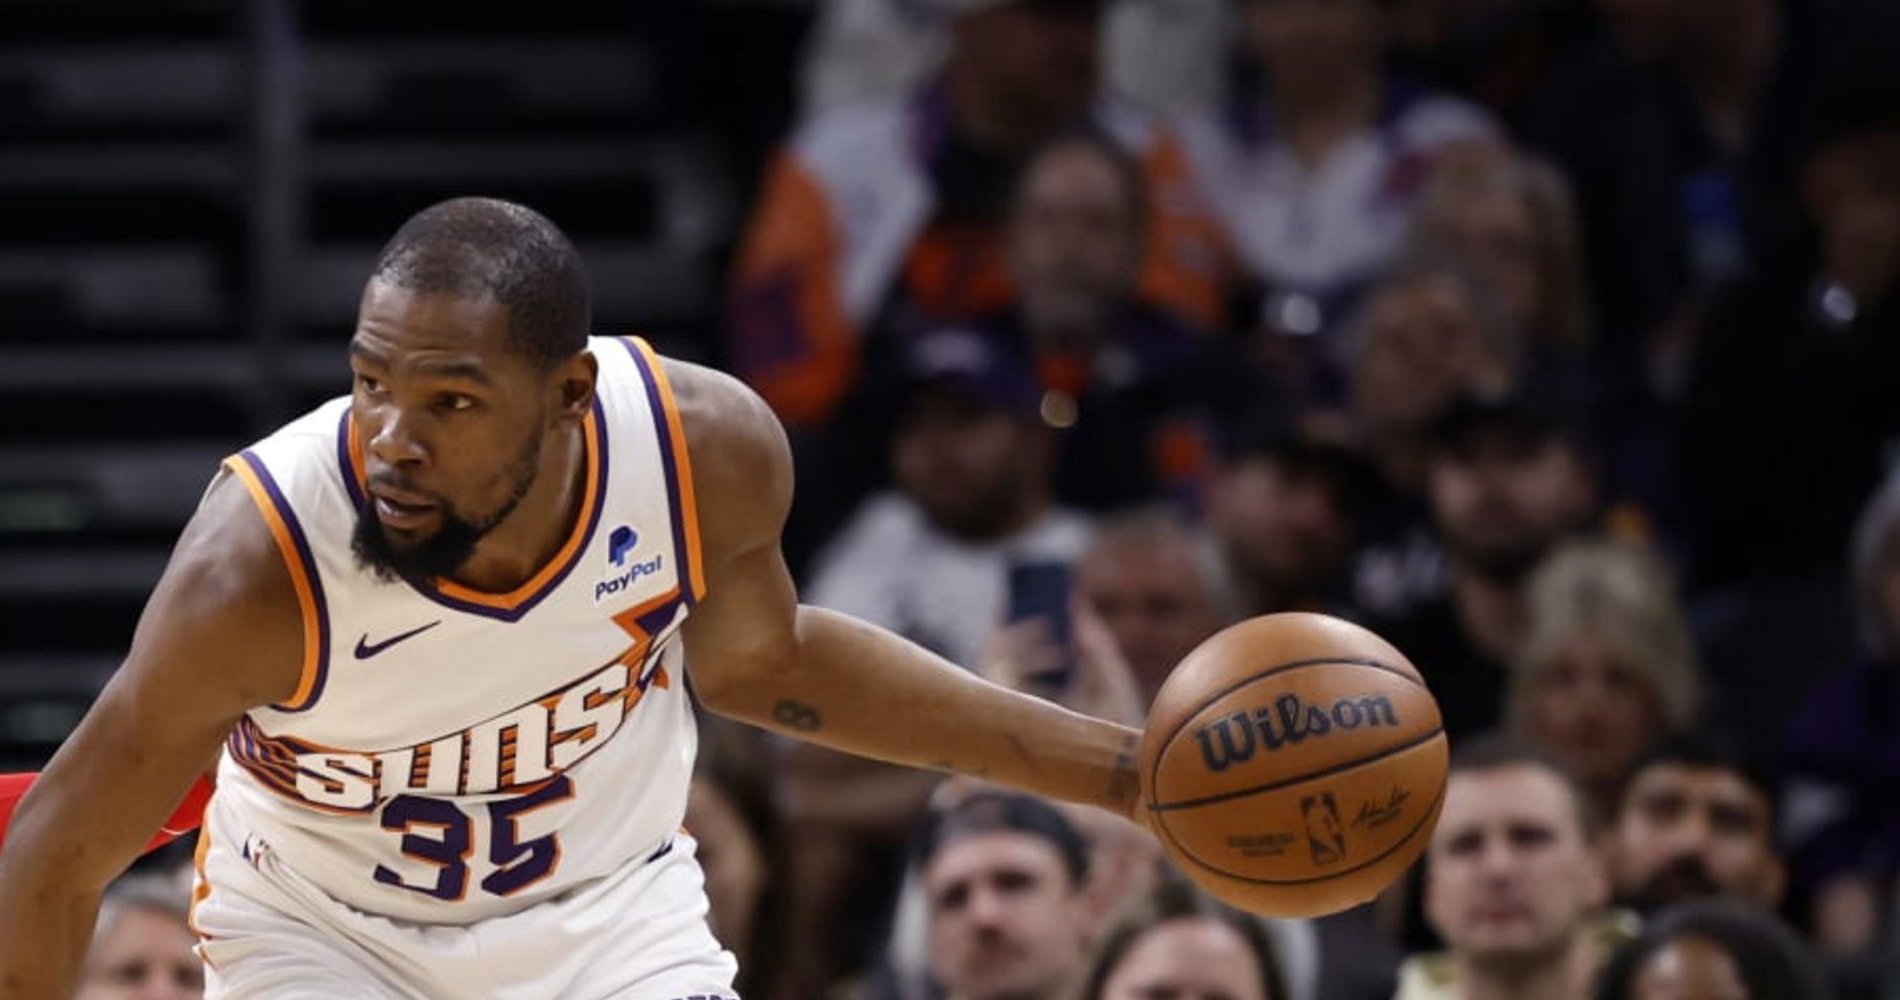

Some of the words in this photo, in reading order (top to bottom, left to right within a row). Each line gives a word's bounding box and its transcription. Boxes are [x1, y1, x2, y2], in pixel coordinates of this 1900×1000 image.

[595, 554, 662, 602] PayPal
[1195, 693, 1398, 772] Wilson
[373, 774, 576, 900] 35
